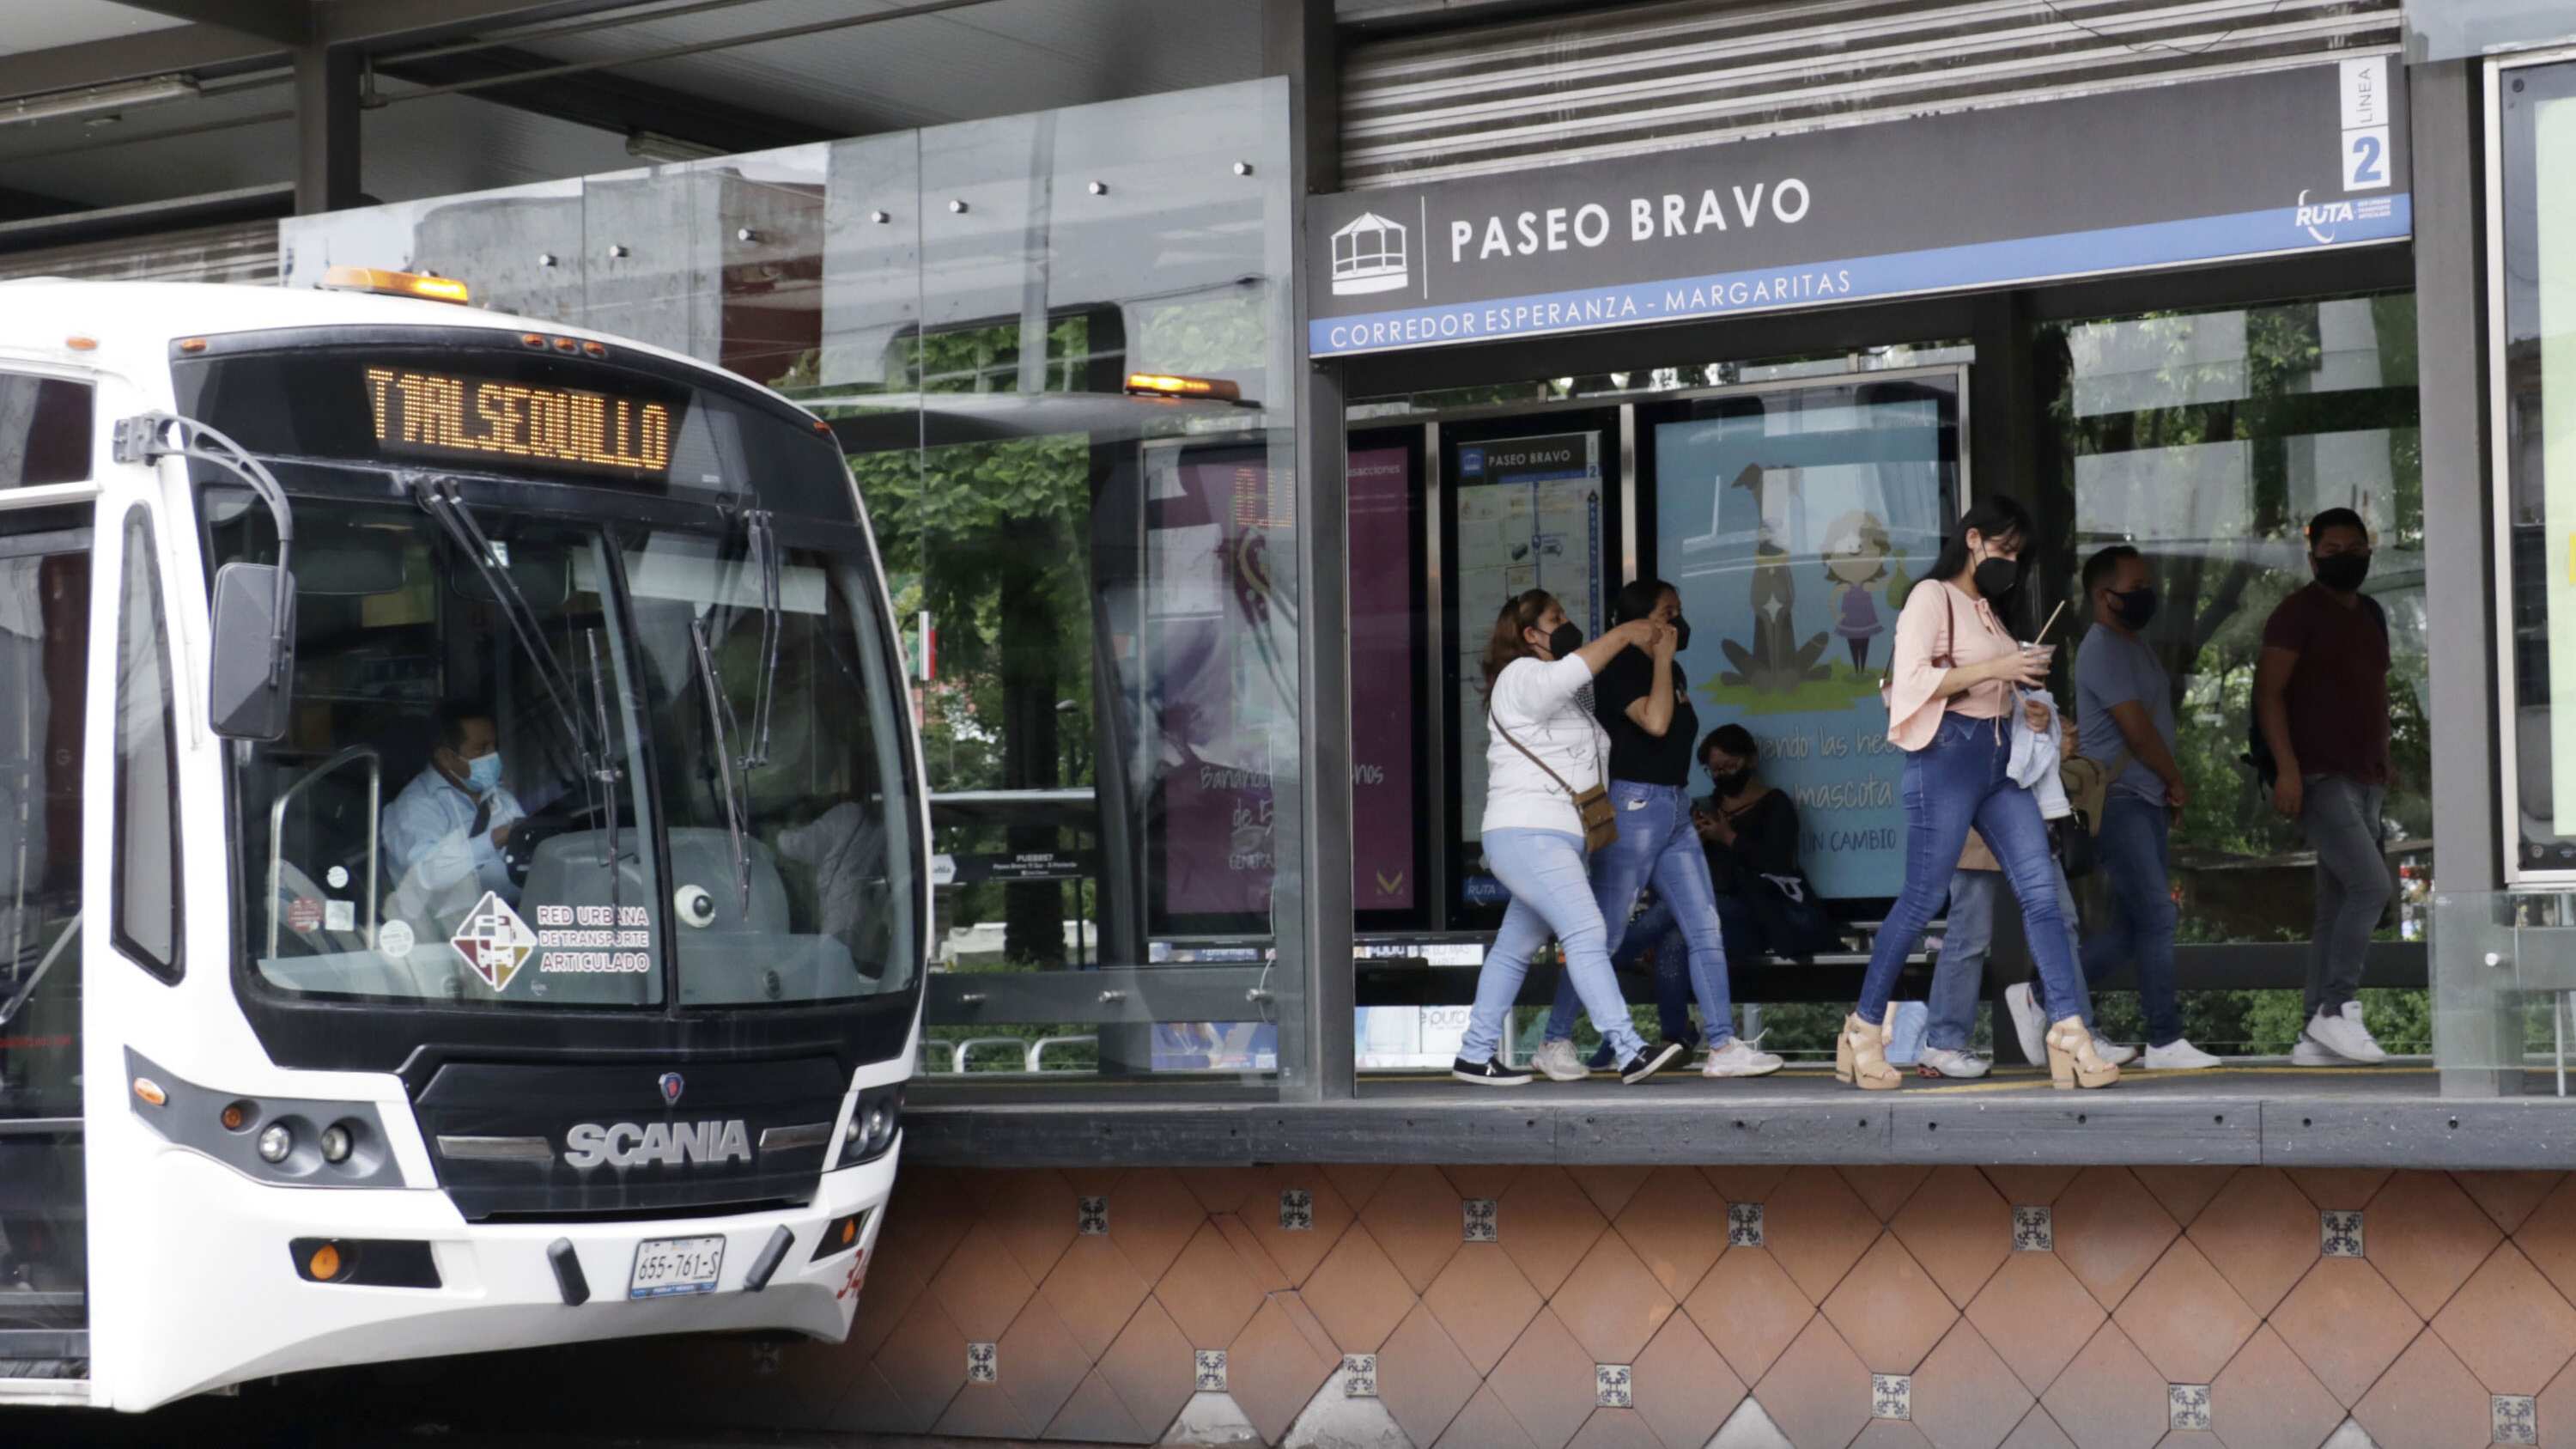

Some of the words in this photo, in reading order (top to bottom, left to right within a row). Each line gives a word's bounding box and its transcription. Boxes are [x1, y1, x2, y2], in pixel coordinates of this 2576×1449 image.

[2352, 136, 2382, 183] 2
[1451, 203, 1611, 263] PASEO
[1631, 178, 1811, 241] BRAVO
[2295, 202, 2354, 227] RUTA
[1331, 311, 1476, 349] CORREDOR
[1485, 294, 1637, 334] ESPERANZA
[1666, 268, 1850, 312] MARGARITAS
[1488, 453, 1526, 468] PASEO
[1529, 448, 1571, 465] BRAVO
[1820, 727, 1847, 757] las
[1793, 771, 1896, 811] mascota
[1232, 797, 1252, 830] de
[1830, 827, 1897, 853] CAMBIO
[1467, 884, 1496, 895] RUTA
[538, 906, 574, 925] RED
[577, 906, 649, 926] URBANA
[539, 931, 559, 947] DE
[560, 930, 649, 947] TRANSPORTE
[540, 953, 650, 971] ARTICULADO
[564, 1119, 751, 1168] SCANIA
[638, 1251, 719, 1280] 655-761-S
